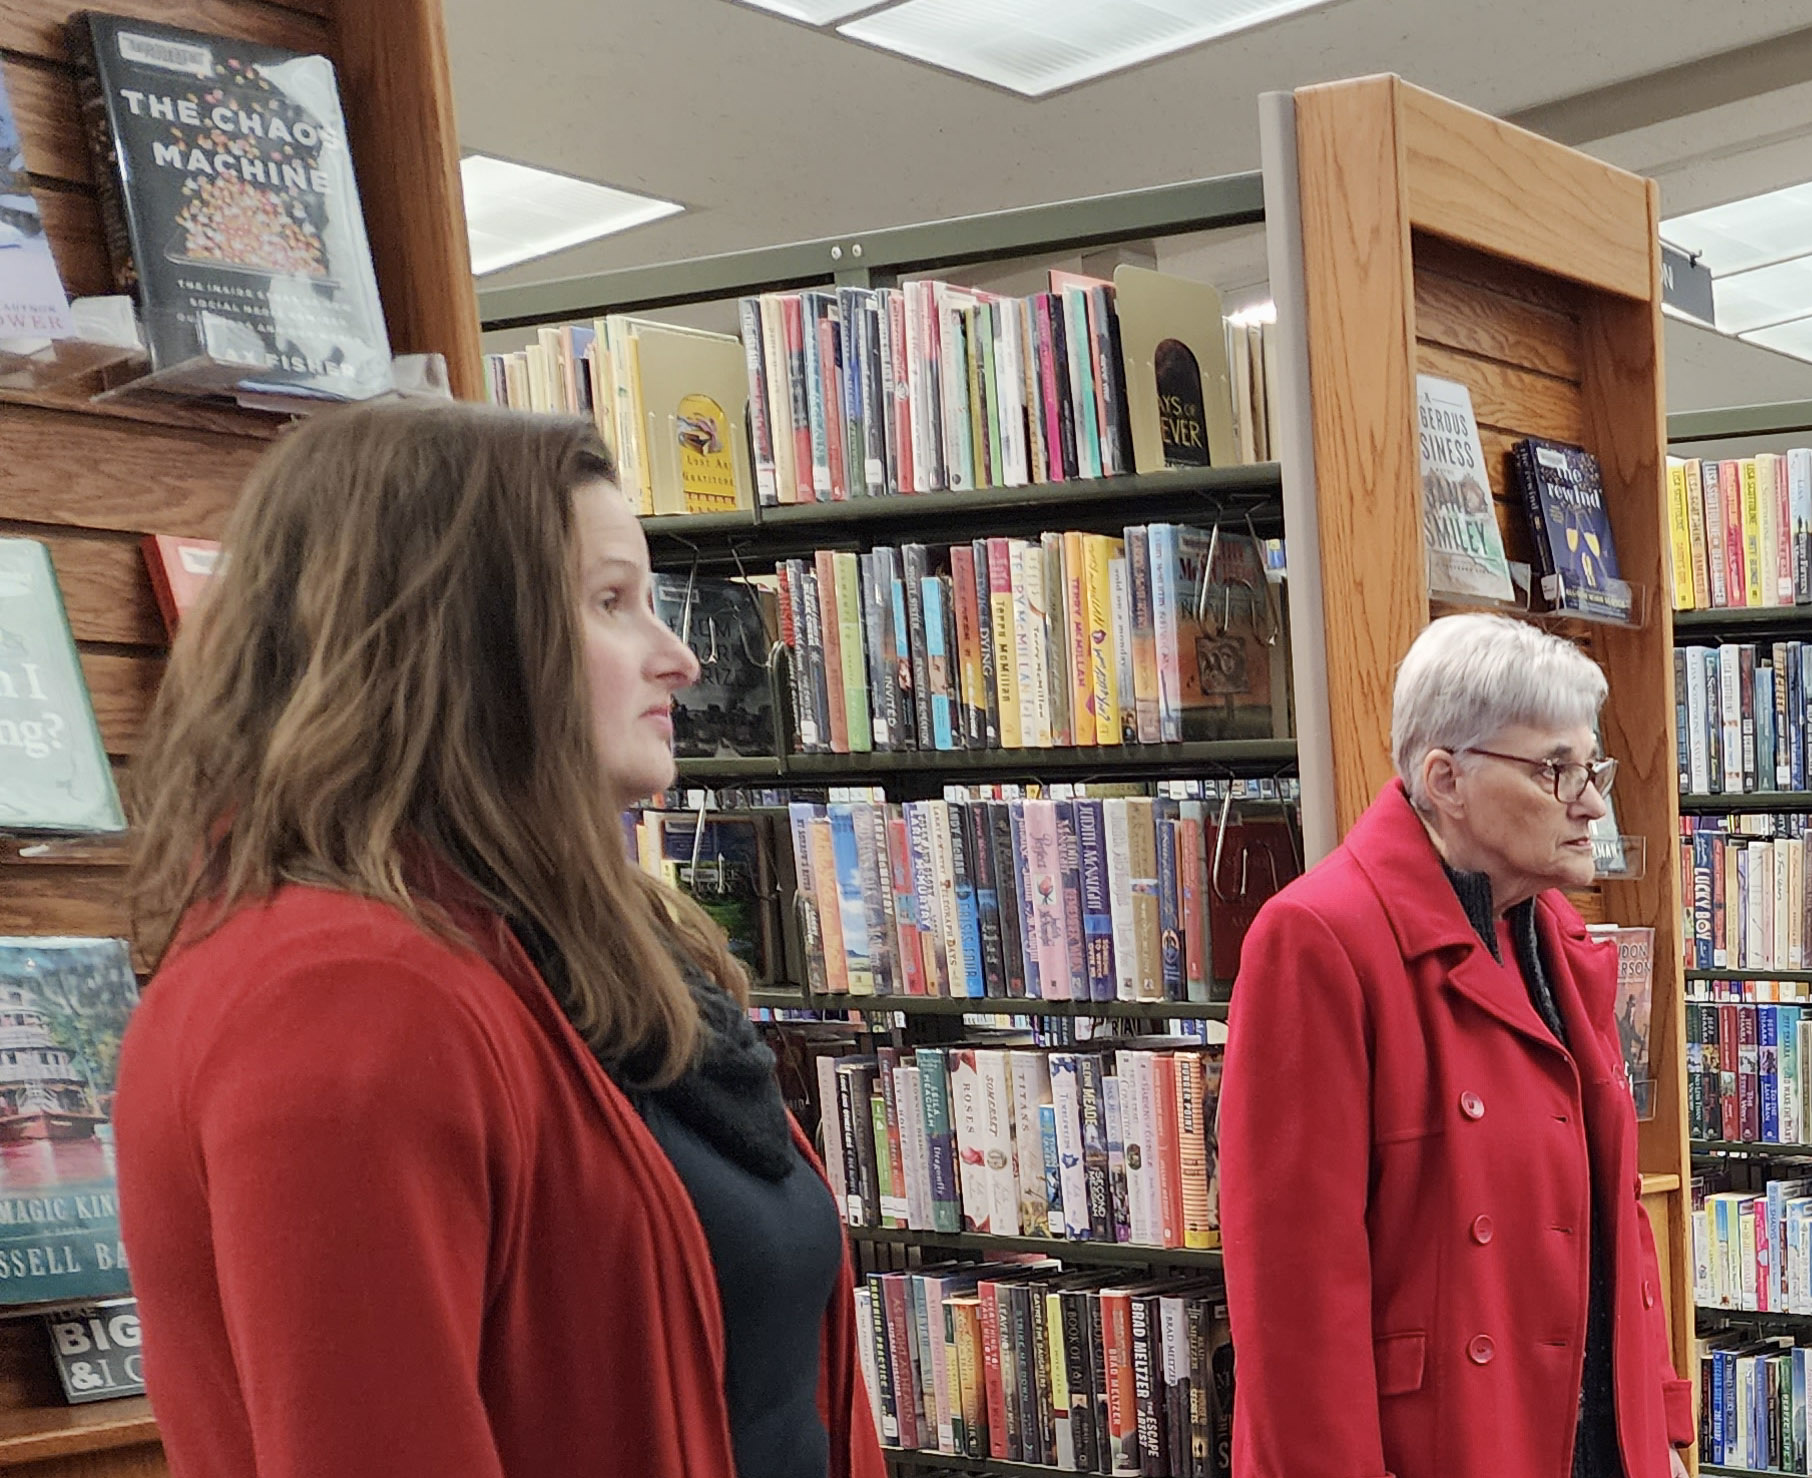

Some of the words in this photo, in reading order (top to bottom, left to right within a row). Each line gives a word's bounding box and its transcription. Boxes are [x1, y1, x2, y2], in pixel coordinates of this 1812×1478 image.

[120, 88, 199, 127] THE
[211, 105, 340, 150] CHAOS
[152, 141, 332, 195] MACHINE
[1420, 406, 1469, 437] GEROUS
[1420, 432, 1475, 469] SINESS
[1694, 867, 1712, 908] LUCKY
[1695, 911, 1711, 941] BOY
[1619, 943, 1648, 958] DON
[962, 1082, 975, 1134] ROSES
[985, 1074, 998, 1137] SOMERSET
[1018, 1073, 1029, 1132] TITANS
[1082, 1088, 1098, 1126] MEADE
[1184, 1102, 1193, 1132] POINT
[75, 1194, 119, 1219] KIN
[998, 1303, 1009, 1333] LEAVE
[1067, 1311, 1079, 1344] BOOK
[1131, 1302, 1146, 1339] BRAD
[1165, 1316, 1174, 1342] BRAD
[1108, 1348, 1119, 1375] BRAD
[1134, 1341, 1150, 1399] MELTZER
[1111, 1379, 1121, 1425] MELTZER
[1136, 1409, 1148, 1448] ARTIST
[1146, 1417, 1159, 1458] ESCAPE
